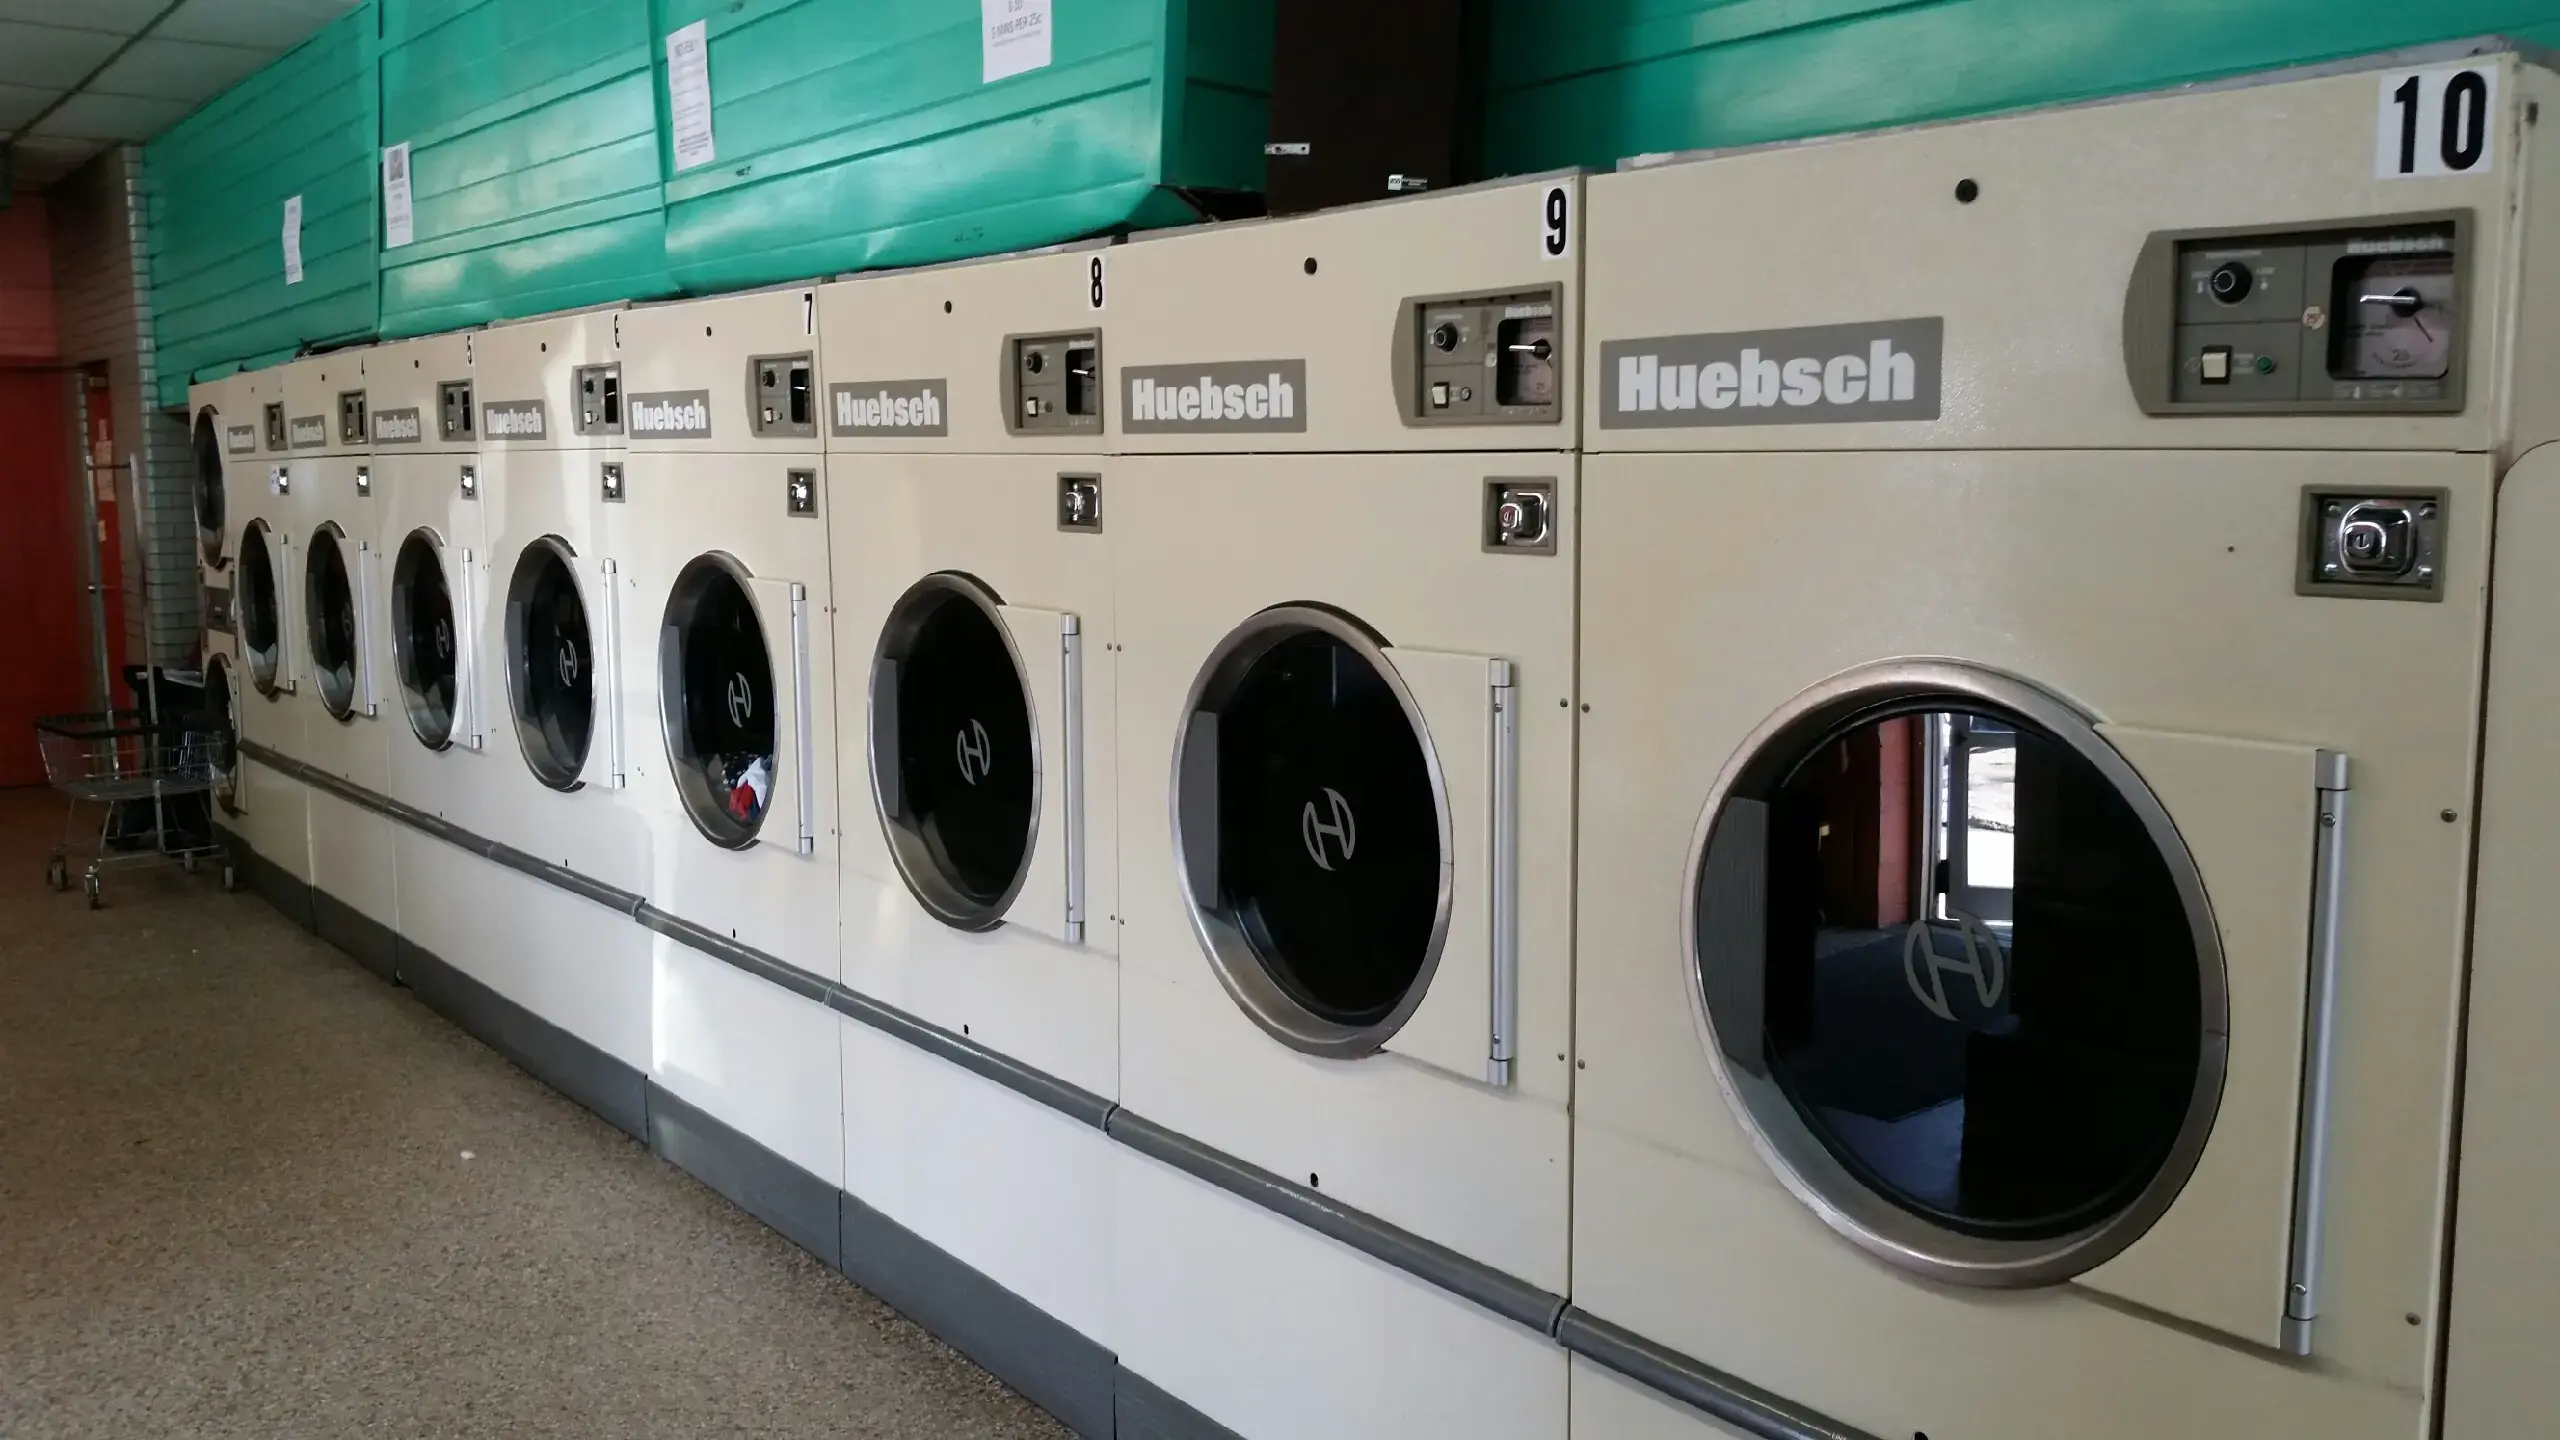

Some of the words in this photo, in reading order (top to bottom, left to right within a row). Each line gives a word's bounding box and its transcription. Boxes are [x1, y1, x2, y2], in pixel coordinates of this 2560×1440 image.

[2393, 70, 2488, 174] 10
[1545, 187, 1567, 257] 9
[1089, 256, 1104, 308] 8
[803, 293, 813, 335] 7
[1132, 372, 1294, 420] Huebsch
[1618, 339, 1915, 412] Huebsch
[486, 407, 542, 435] Huebsch
[631, 399, 706, 432] Huebsch
[836, 389, 940, 427] Huebsch
